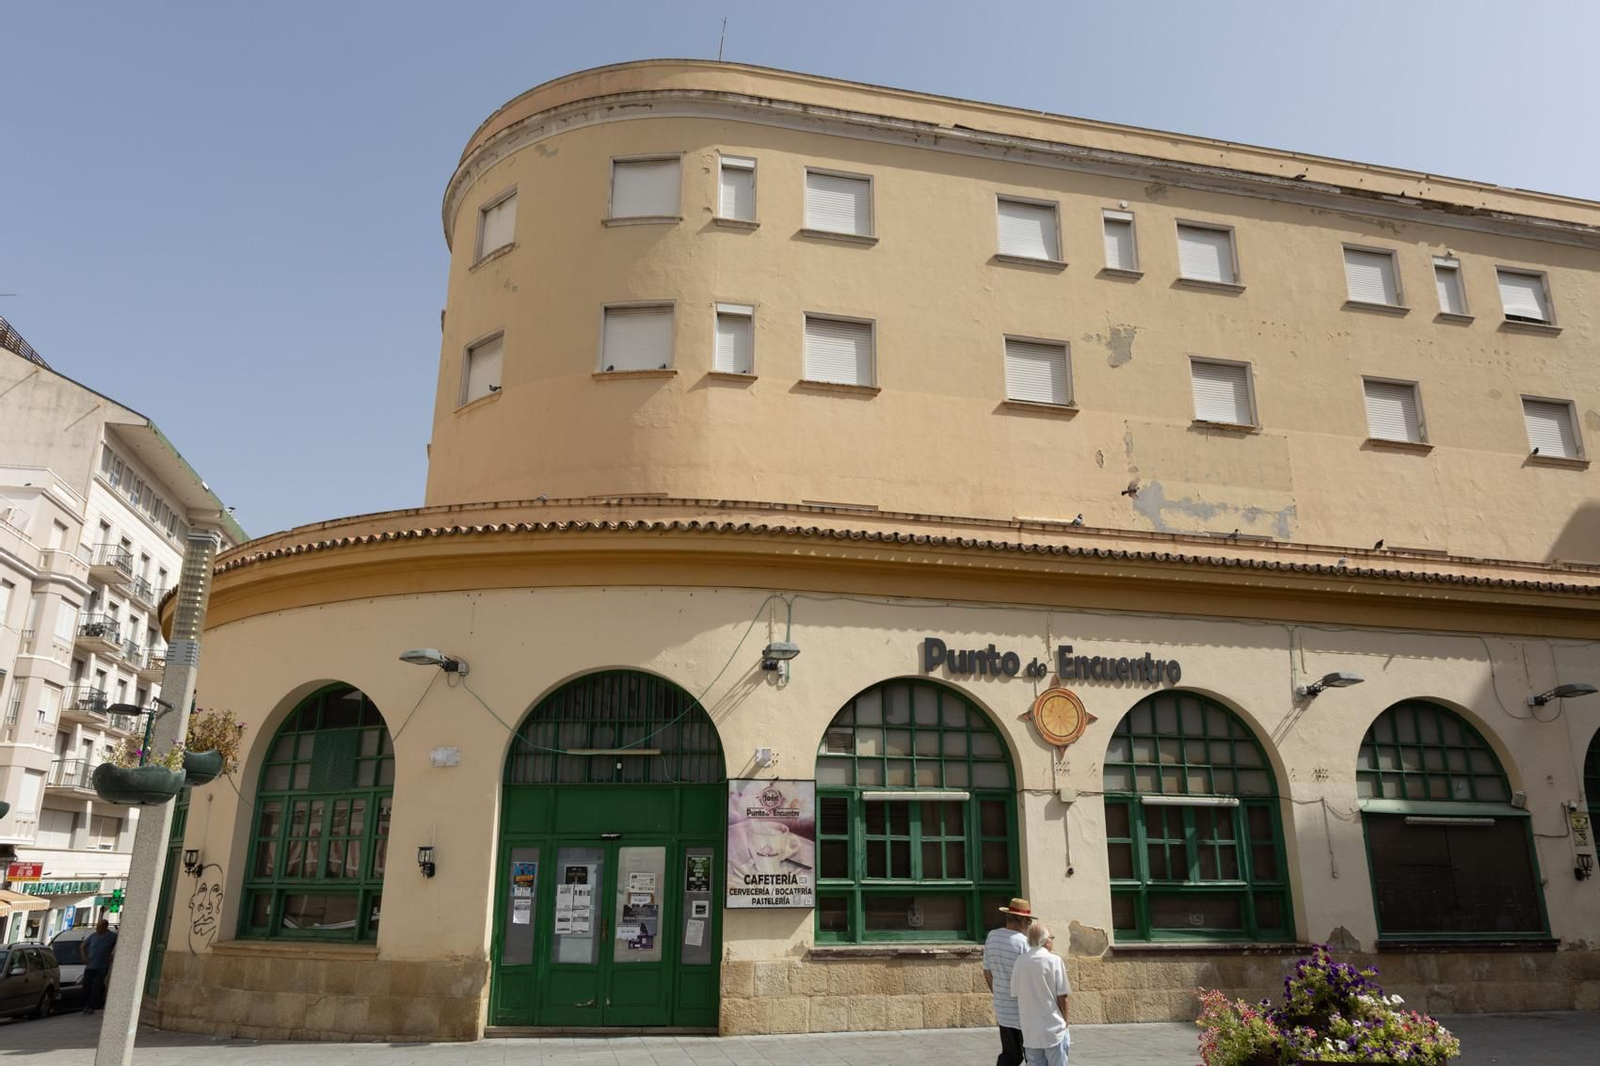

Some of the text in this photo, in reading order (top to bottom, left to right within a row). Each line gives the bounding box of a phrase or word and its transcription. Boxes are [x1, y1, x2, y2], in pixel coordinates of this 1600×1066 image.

[924, 637, 1182, 684] Punto de Encuentro
[746, 808, 765, 817] Punto
[773, 809, 800, 817] Encuentro
[744, 871, 798, 885] CAFETERÍA
[24, 881, 80, 894] FARMACIA
[729, 886, 770, 895] CERVECERÍA
[775, 886, 812, 895] BOCATERÍA
[752, 895, 790, 905] PASTELERÍA
